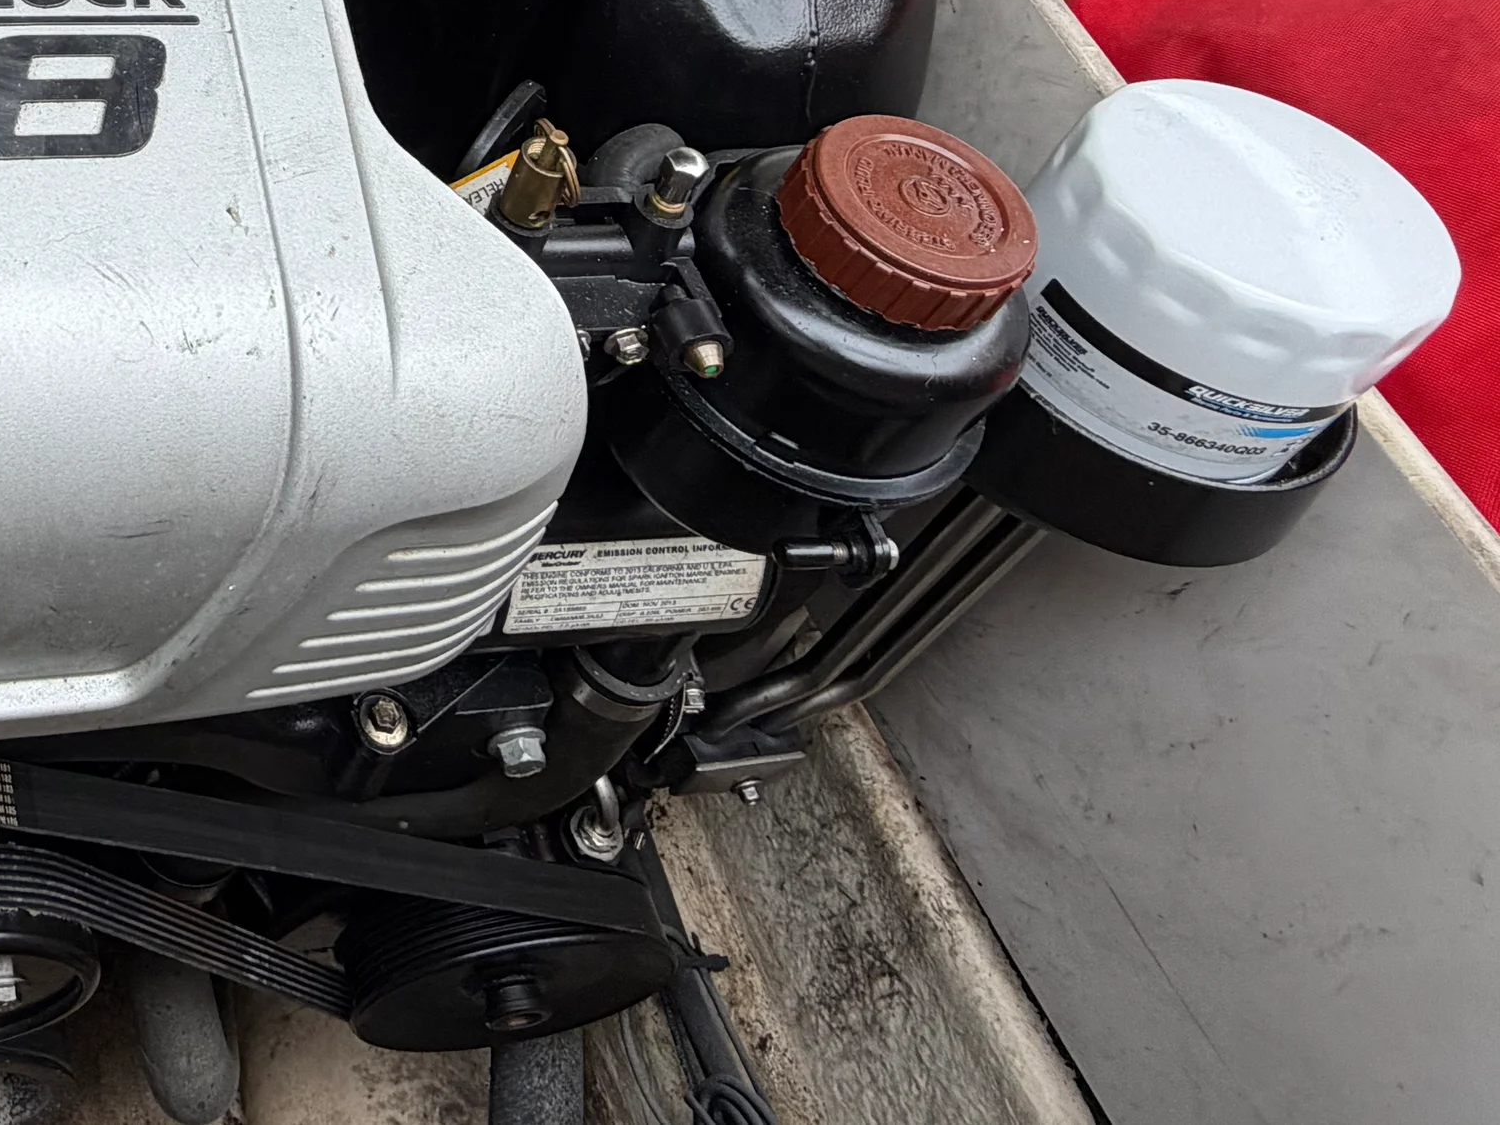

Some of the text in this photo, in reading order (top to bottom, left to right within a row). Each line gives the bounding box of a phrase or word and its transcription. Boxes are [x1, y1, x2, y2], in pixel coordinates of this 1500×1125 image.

[1147, 422, 1268, 455] 35-866340Q03
[597, 548, 643, 557] EMISSION
[645, 545, 689, 555] CONTROL
